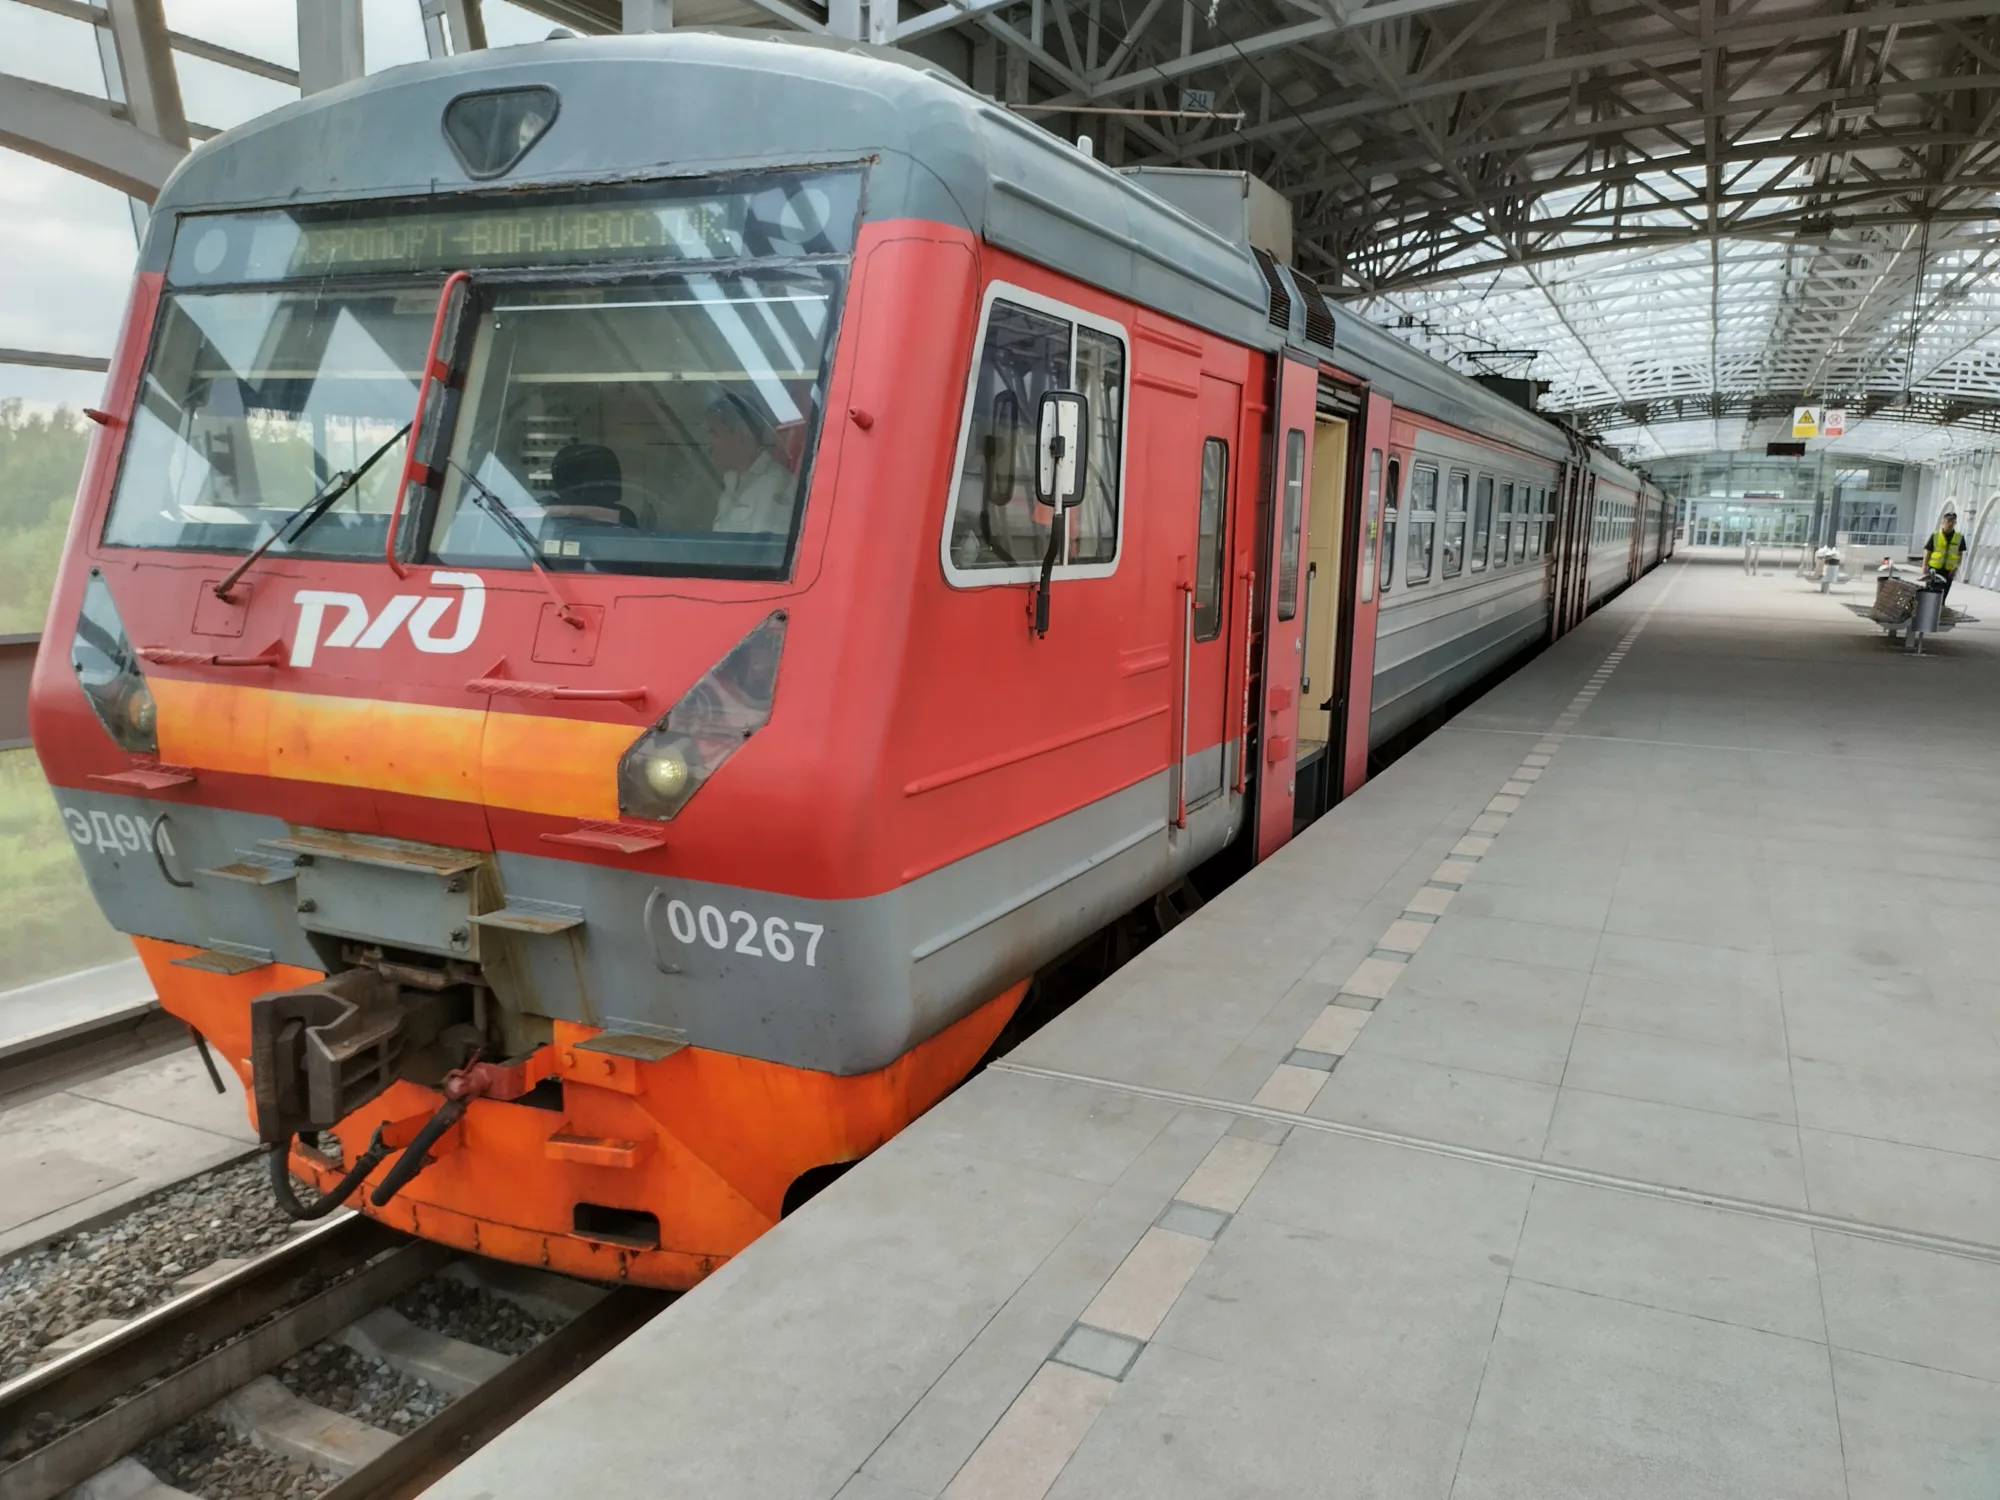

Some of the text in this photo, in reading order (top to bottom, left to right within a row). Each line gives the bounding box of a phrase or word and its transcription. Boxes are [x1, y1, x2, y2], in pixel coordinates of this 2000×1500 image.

[289, 570, 486, 668] РЖД
[63, 807, 175, 856] ЭД9М
[667, 900, 825, 967] 00267
